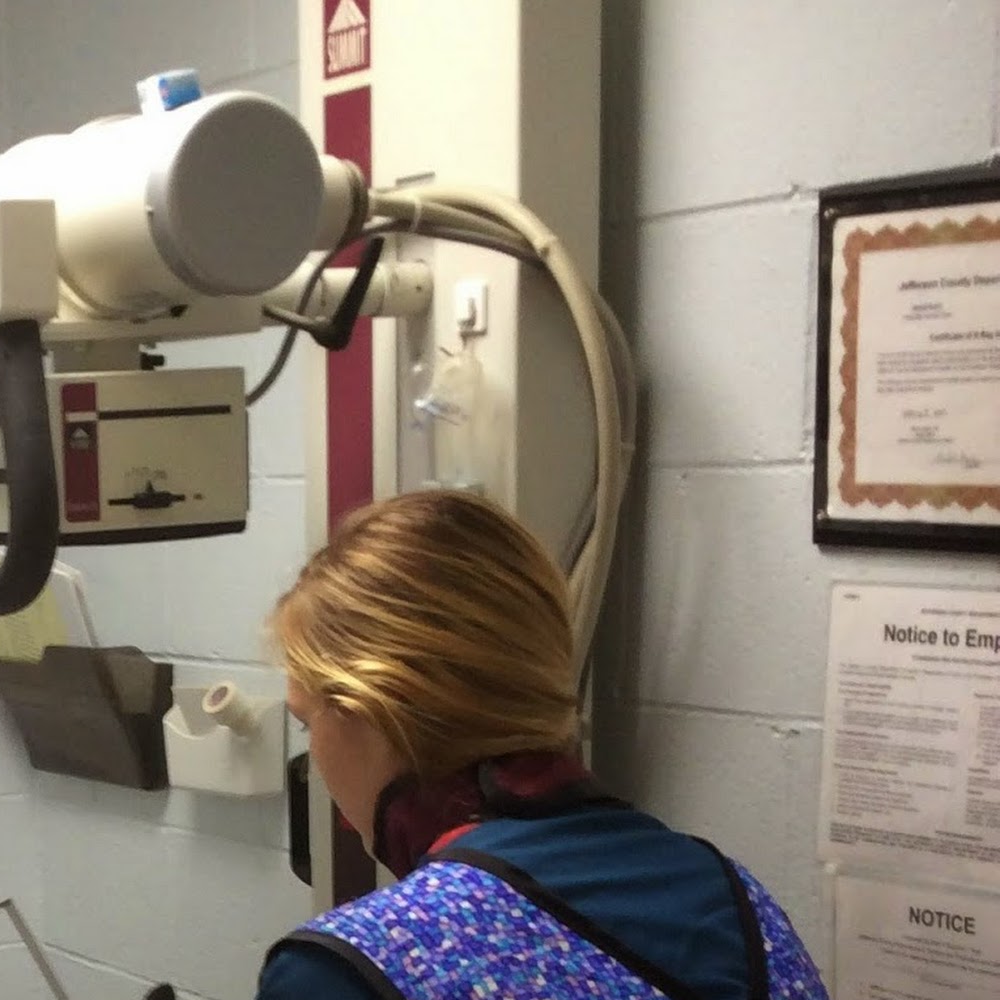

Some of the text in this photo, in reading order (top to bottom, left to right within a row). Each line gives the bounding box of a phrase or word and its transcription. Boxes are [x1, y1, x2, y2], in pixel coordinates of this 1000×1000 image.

[328, 27, 366, 73] SUMMIT
[884, 623, 938, 645] Notice
[943, 628, 960, 647] to
[909, 906, 976, 935] NOTICE
